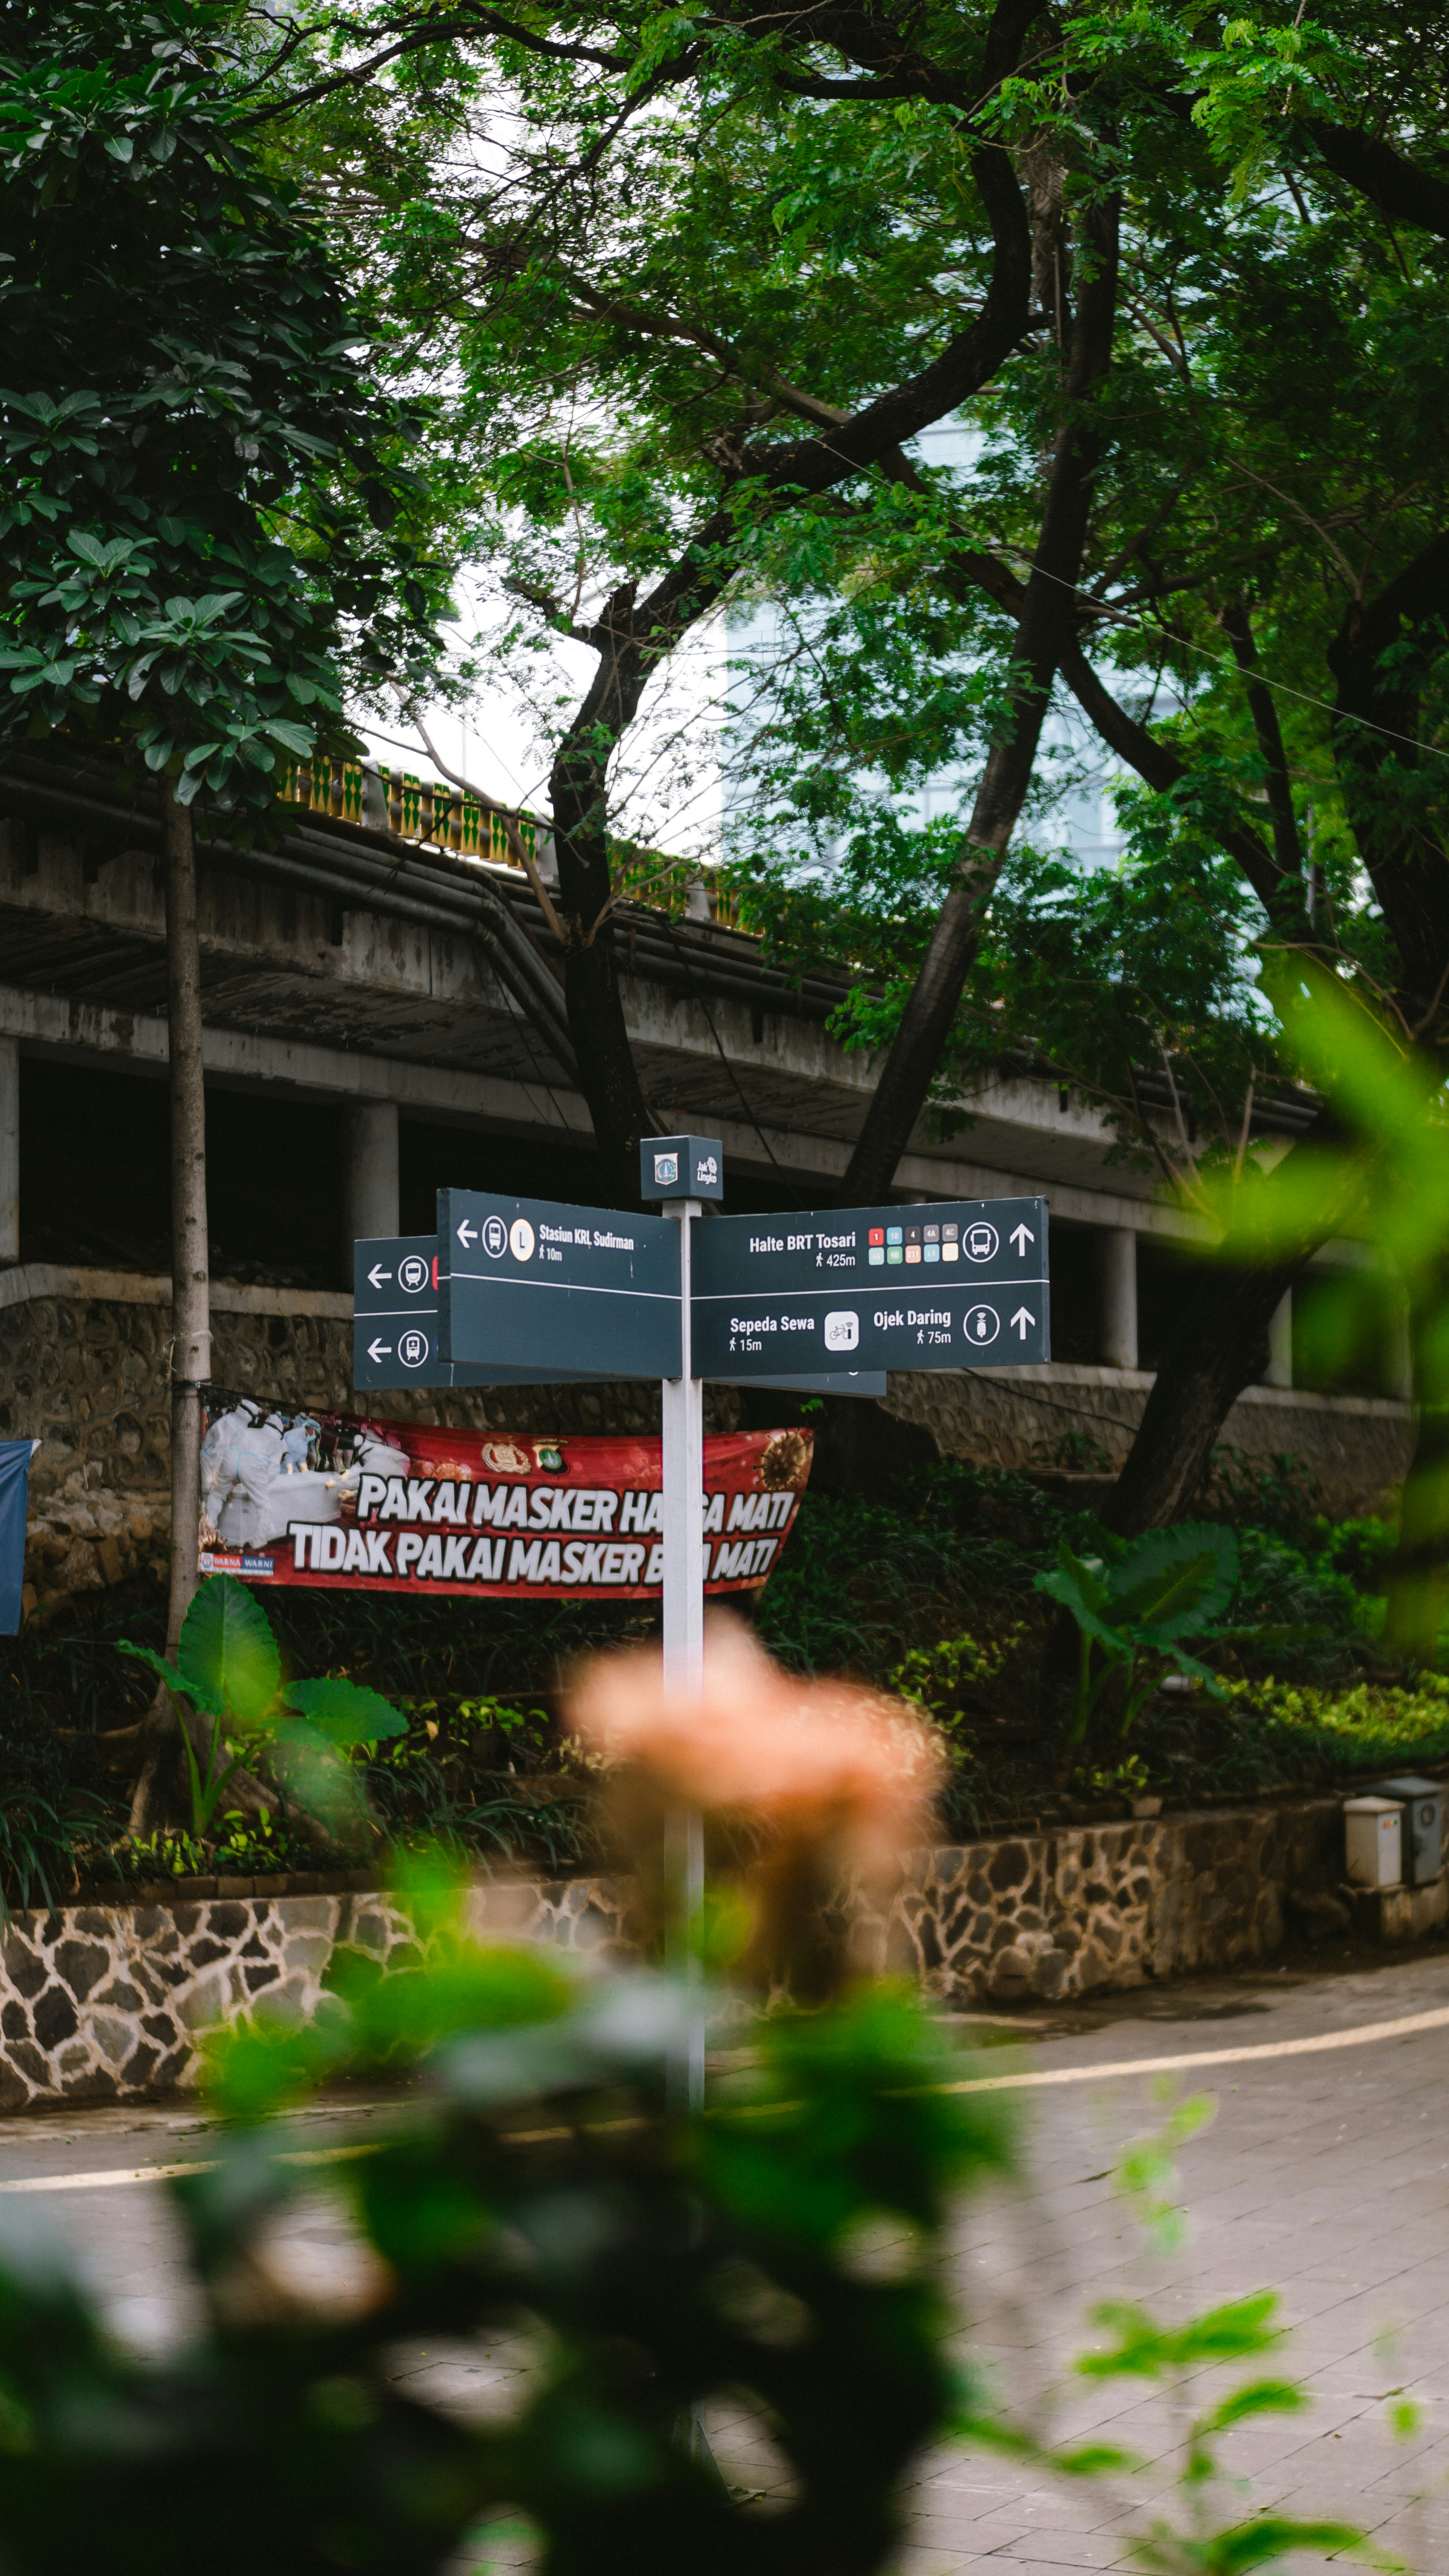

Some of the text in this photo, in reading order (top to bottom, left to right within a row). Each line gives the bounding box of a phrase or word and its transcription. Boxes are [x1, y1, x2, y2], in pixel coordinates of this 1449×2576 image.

[697, 1161, 707, 1172] Jak
[697, 1171, 717, 1185] Lingko
[519, 1231, 525, 1249] L
[540, 1224, 634, 1250] Stasiun KRL Sudirman
[750, 1231, 855, 1252] Halte BRT Tosari
[546, 1248, 562, 1261] 10m
[826, 1254, 855, 1267] 425m
[730, 1315, 815, 1336] Sepeda Sewa
[874, 1309, 951, 1331] Ojek Daring
[740, 1339, 762, 1351] 15m
[928, 1331, 952, 1344] 75m
[358, 1475, 795, 1532] PAKAI MASKER HAA MATI
[289, 1522, 393, 1574] TIDAK
[396, 1532, 506, 1580] PAKAI
[508, 1539, 646, 1583] MASKER
[711, 1539, 778, 1580] MATI
[214, 1557, 273, 1568] WARNA WARNI
